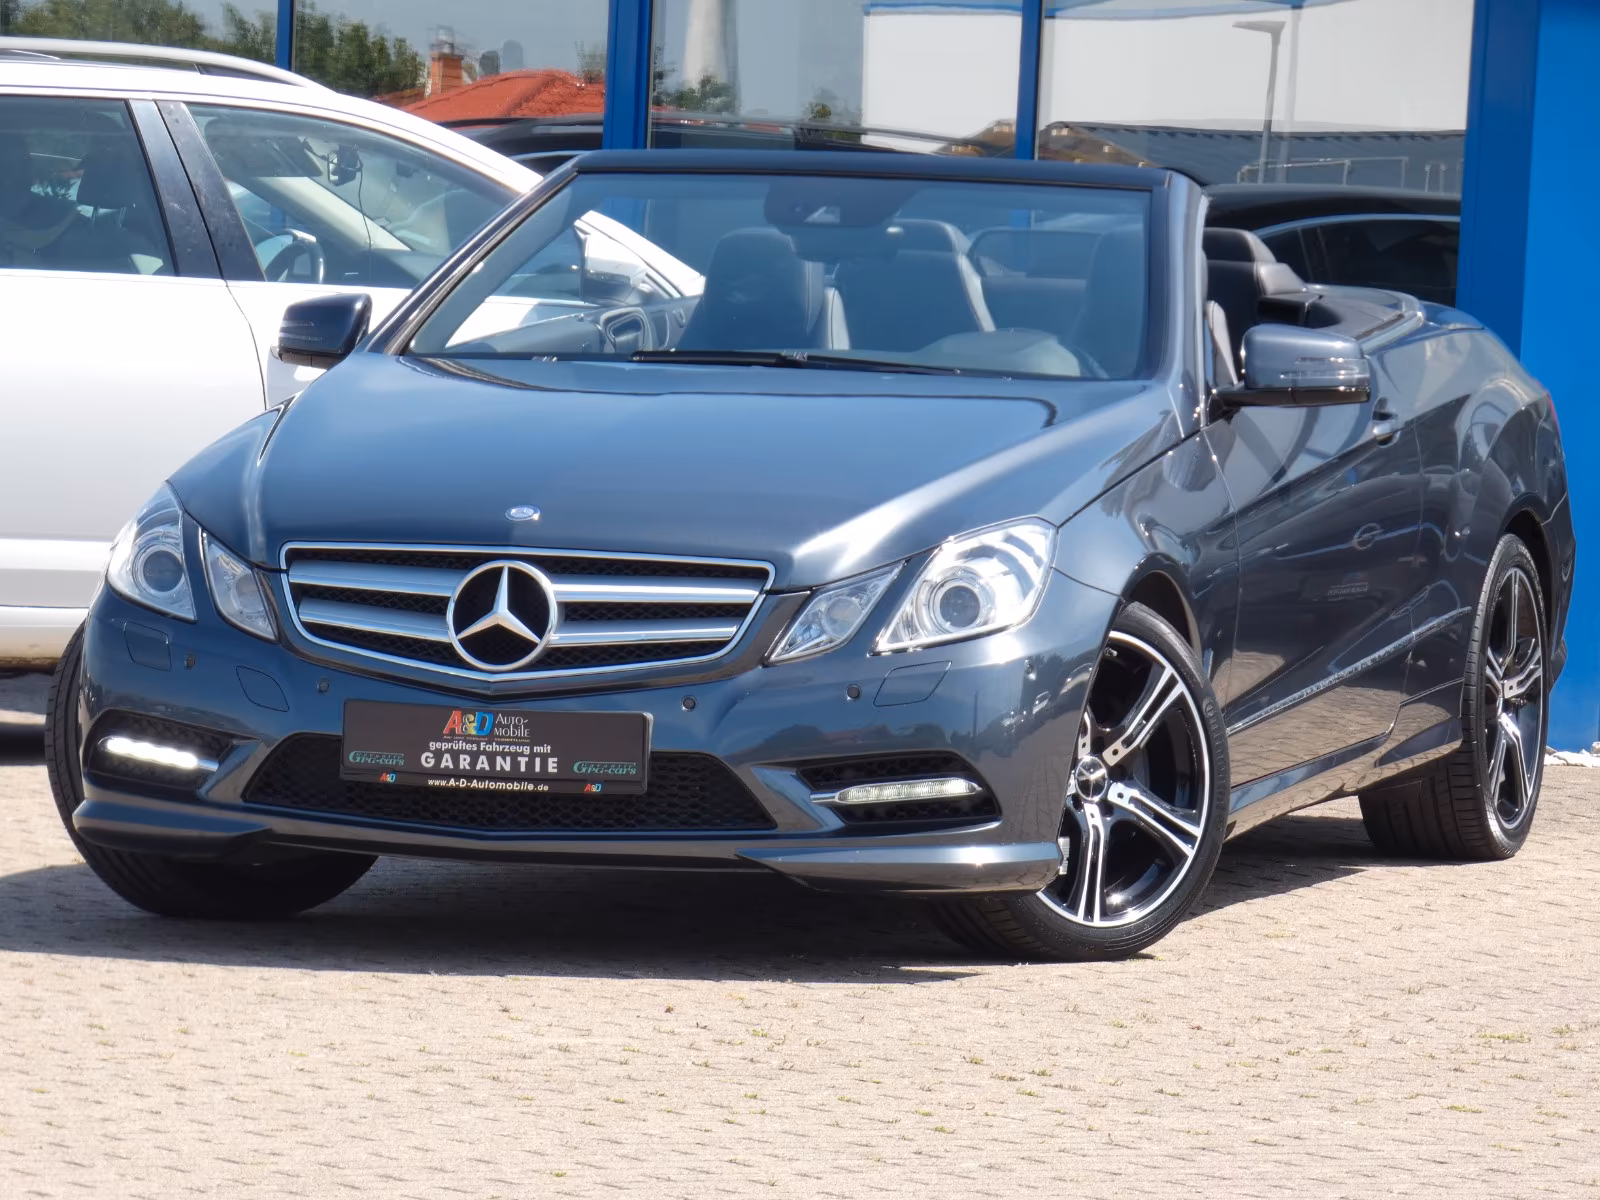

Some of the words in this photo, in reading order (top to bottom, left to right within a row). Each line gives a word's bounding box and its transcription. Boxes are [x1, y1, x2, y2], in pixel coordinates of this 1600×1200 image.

[443, 710, 495, 736] A&D
[429, 740, 478, 752] geprüftes
[480, 742, 531, 755] Fahrzeug
[533, 744, 552, 754] mit
[420, 751, 558, 773] GARANTIE
[427, 777, 549, 792] www.A-D-Automobile.de
